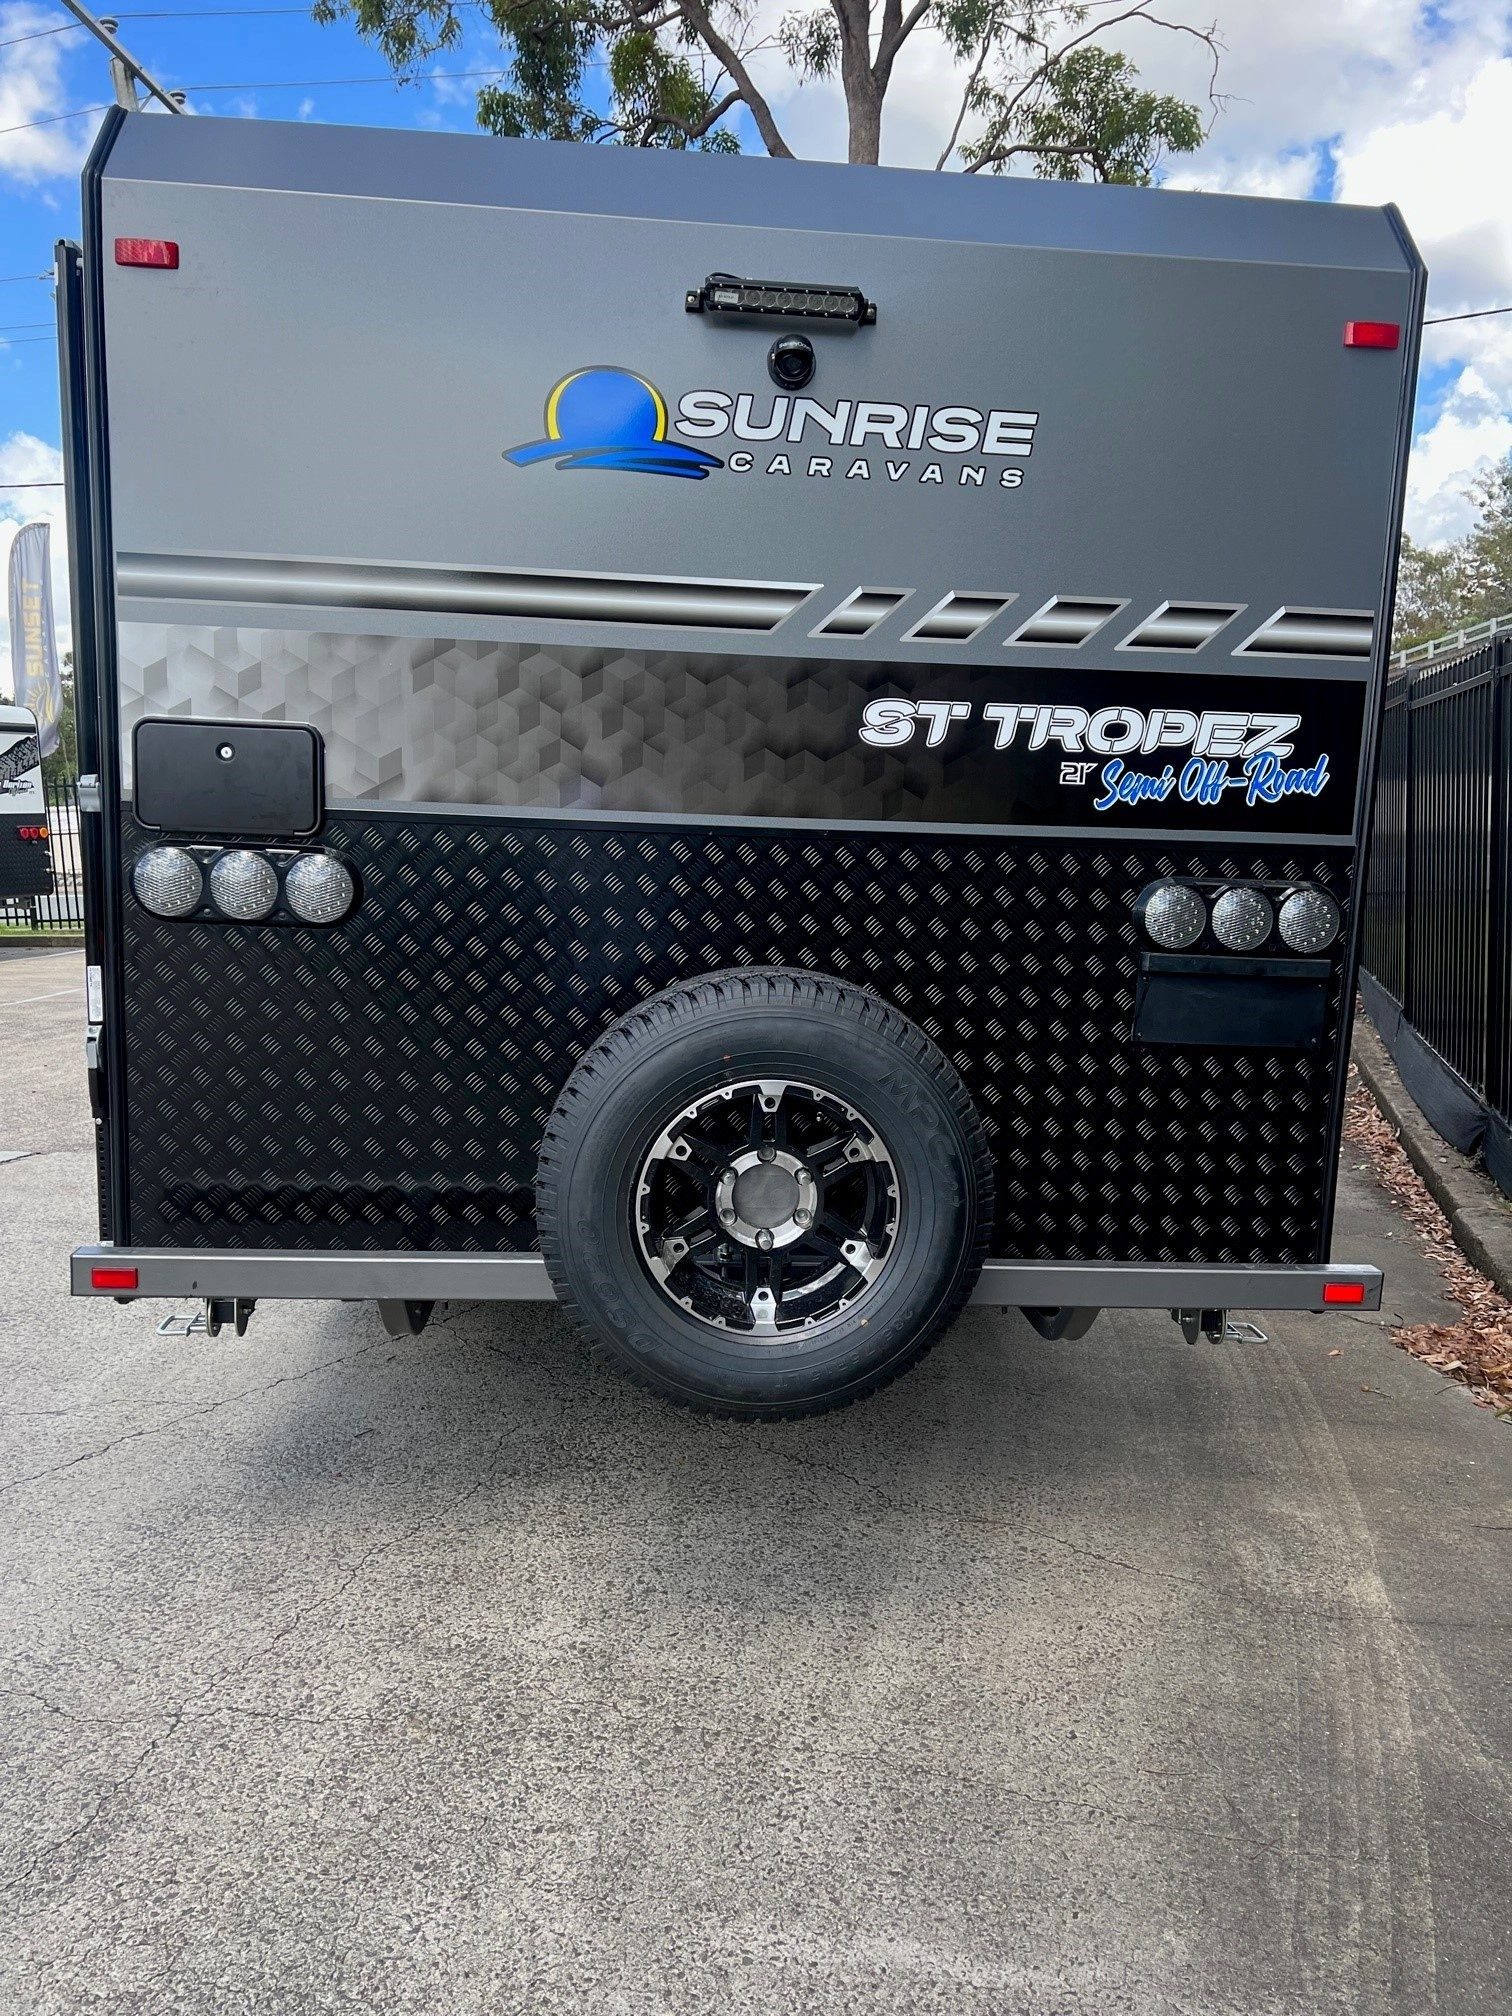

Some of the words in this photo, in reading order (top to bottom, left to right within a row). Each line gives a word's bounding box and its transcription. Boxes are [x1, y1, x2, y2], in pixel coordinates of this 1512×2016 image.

[674, 389, 1040, 457] SUNRISE
[728, 450, 1025, 489] CARAVANS
[22, 577, 44, 676] SUNSET
[858, 697, 972, 748] ST
[983, 702, 1303, 759] TROPEZ
[1094, 757, 1176, 811] Semi
[1178, 750, 1330, 807] Off-Road
